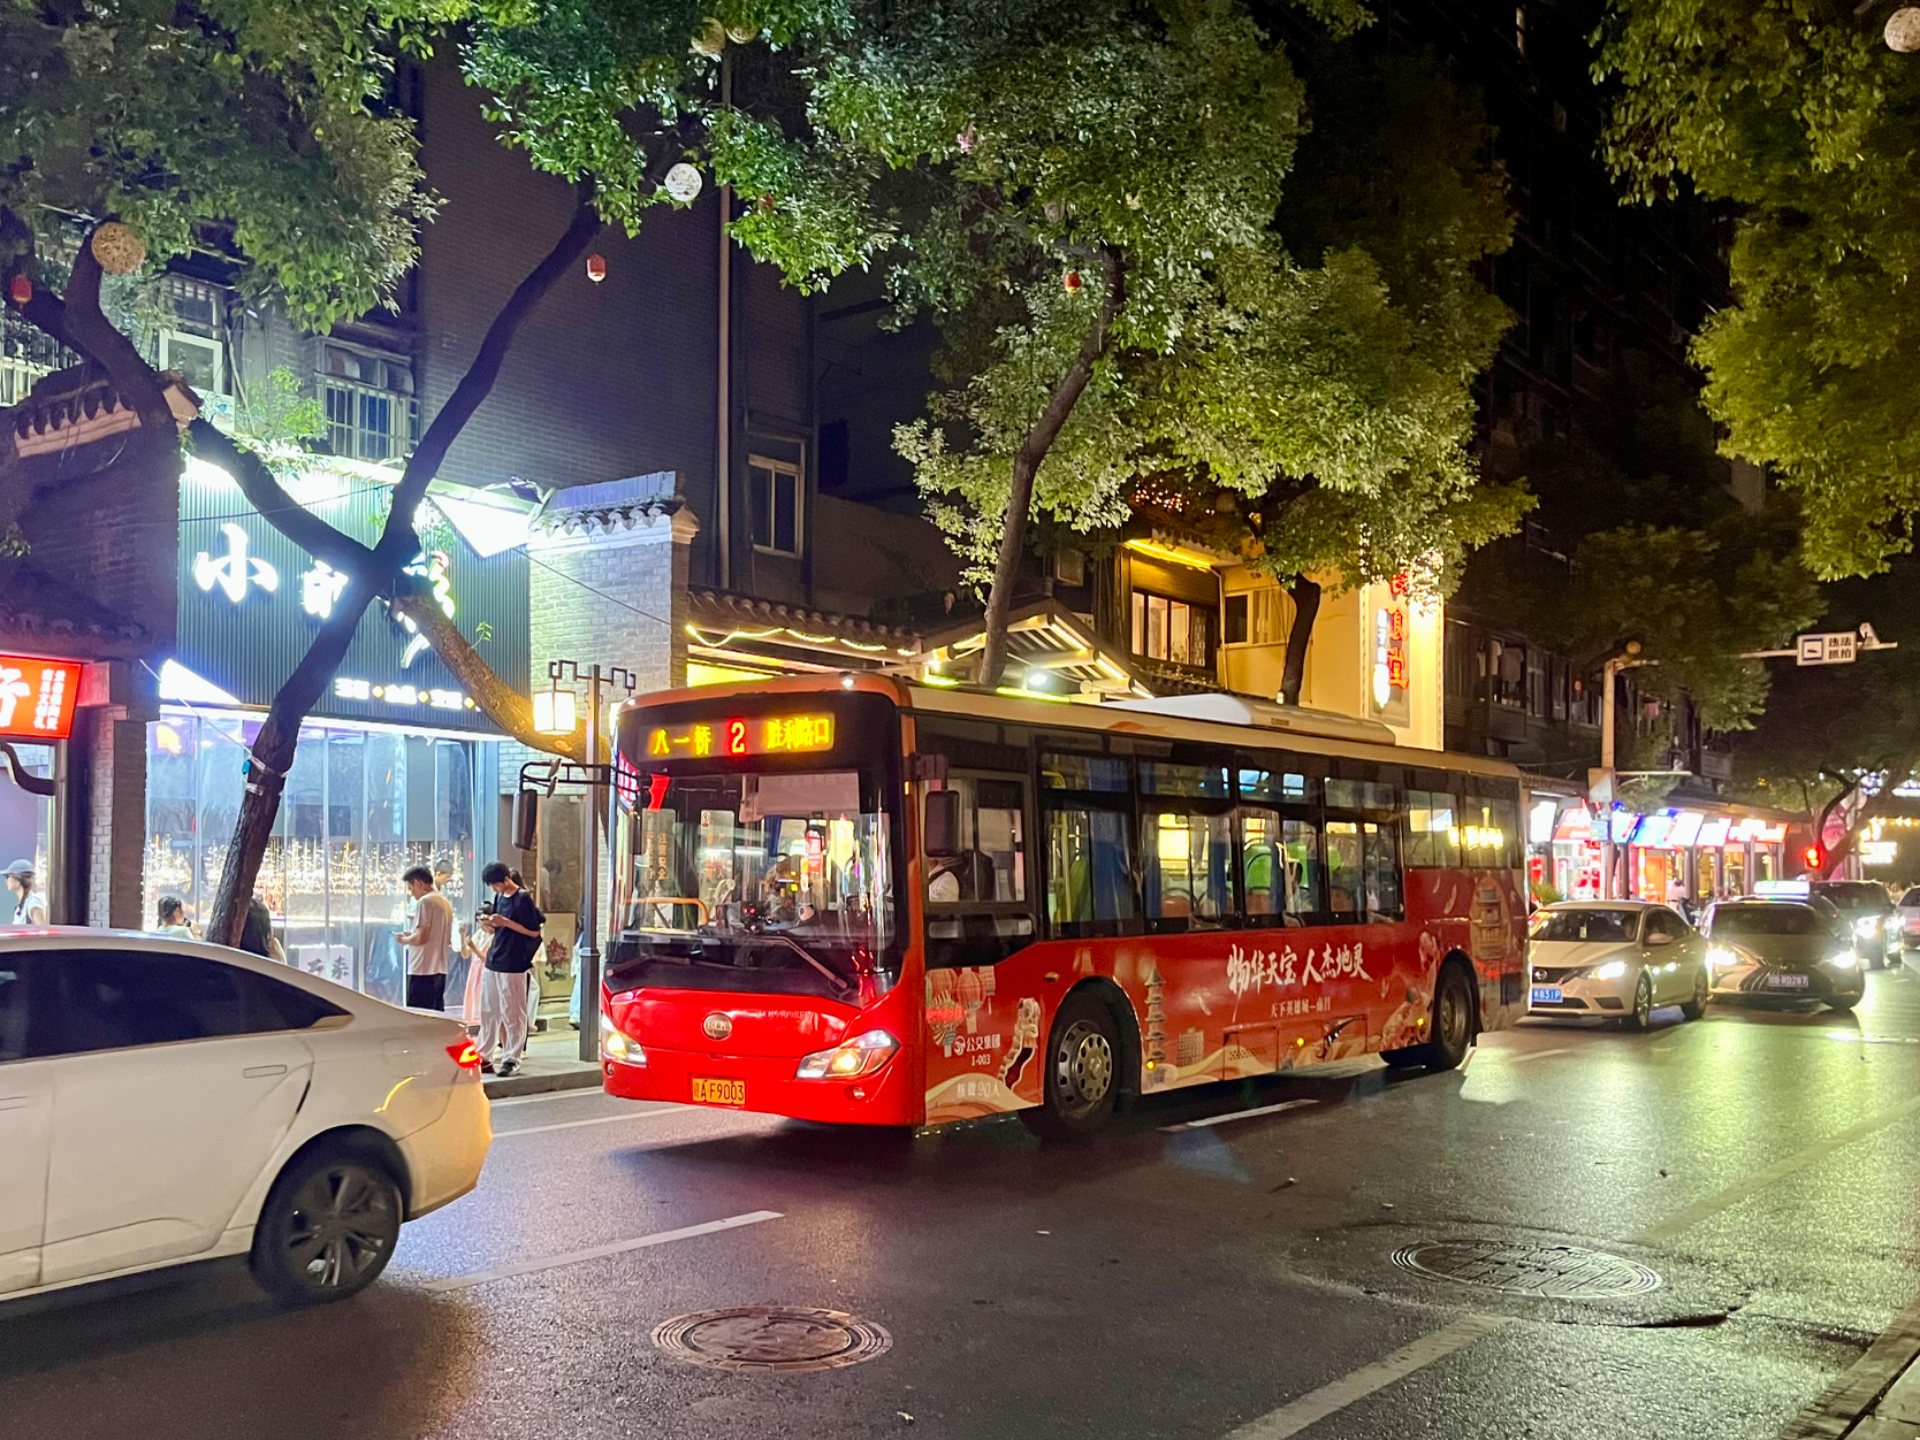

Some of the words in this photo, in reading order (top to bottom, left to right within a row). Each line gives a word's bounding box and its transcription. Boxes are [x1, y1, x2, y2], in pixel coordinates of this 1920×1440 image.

[653, 725, 711, 756] 八一桥
[731, 721, 745, 753] 2
[767, 717, 830, 750] 胜利路口
[1226, 943, 1298, 1008] 物华天宝
[1302, 942, 1374, 987] 人杰地灵
[971, 1054, 991, 1066] 1-003
